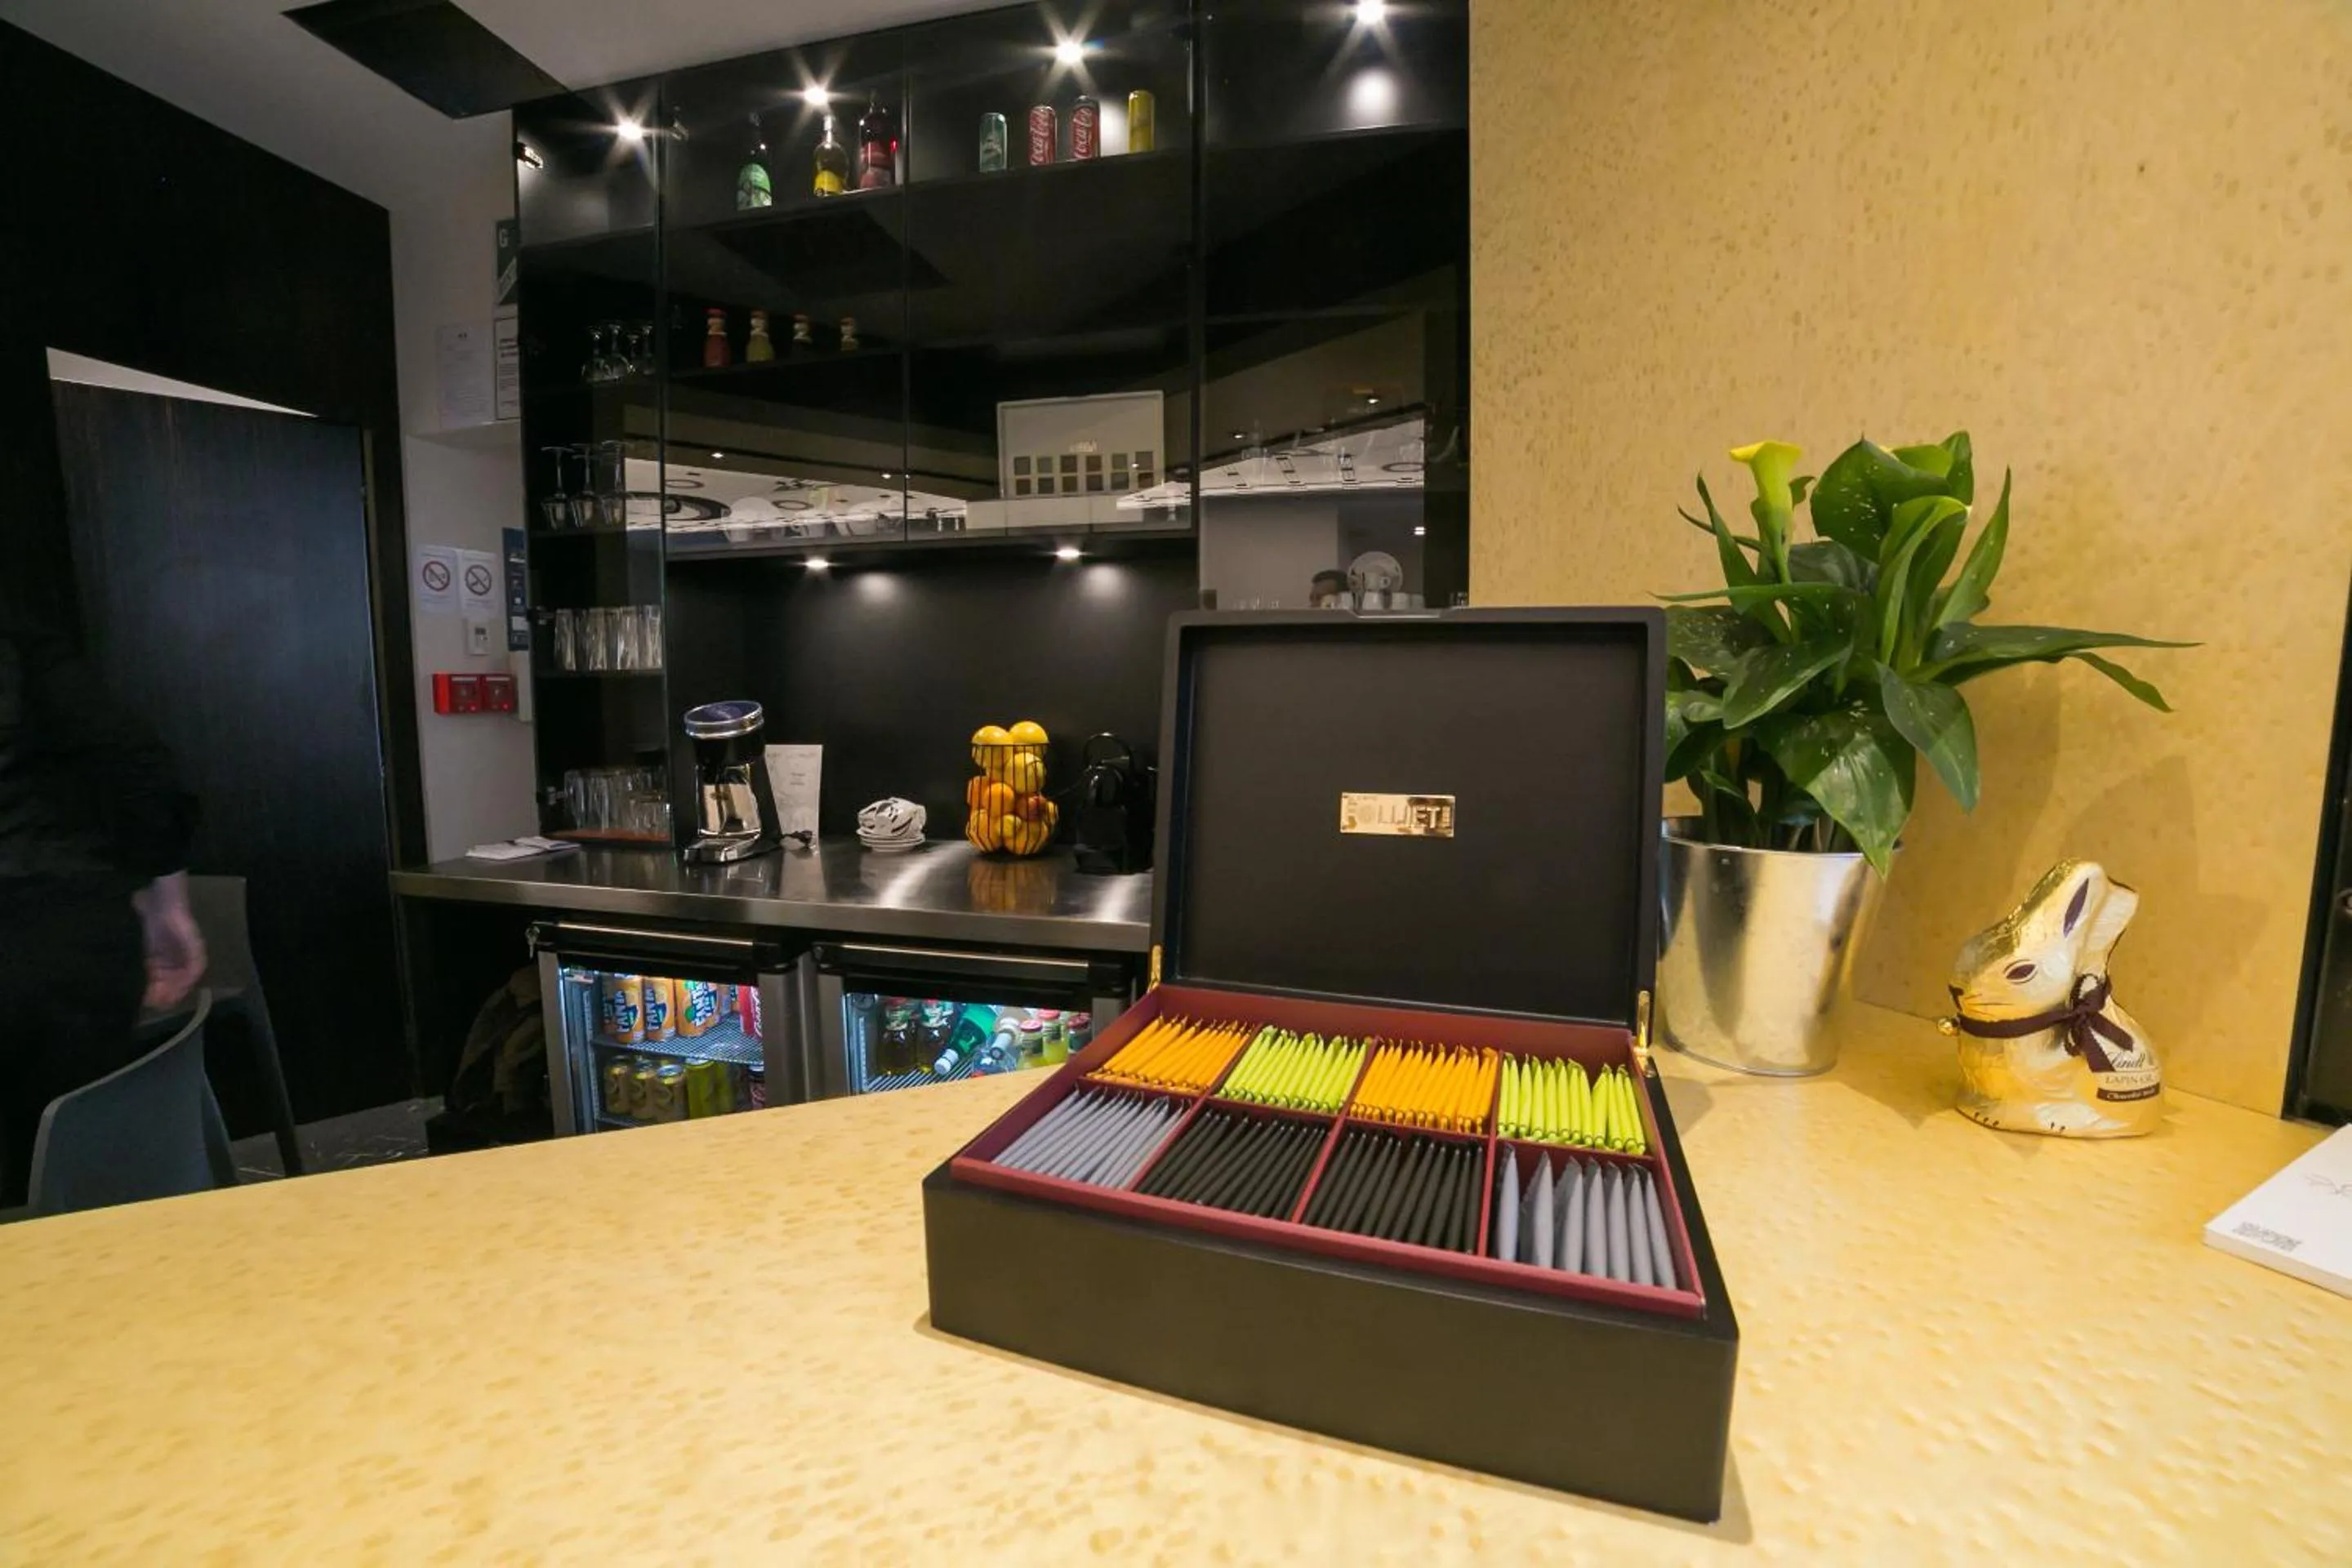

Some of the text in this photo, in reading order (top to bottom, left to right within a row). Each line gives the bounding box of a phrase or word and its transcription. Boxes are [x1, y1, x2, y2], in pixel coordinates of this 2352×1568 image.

[614, 990, 630, 1033] FANTA
[644, 987, 660, 1031] FANTA
[2106, 1050, 2146, 1069] Lindt
